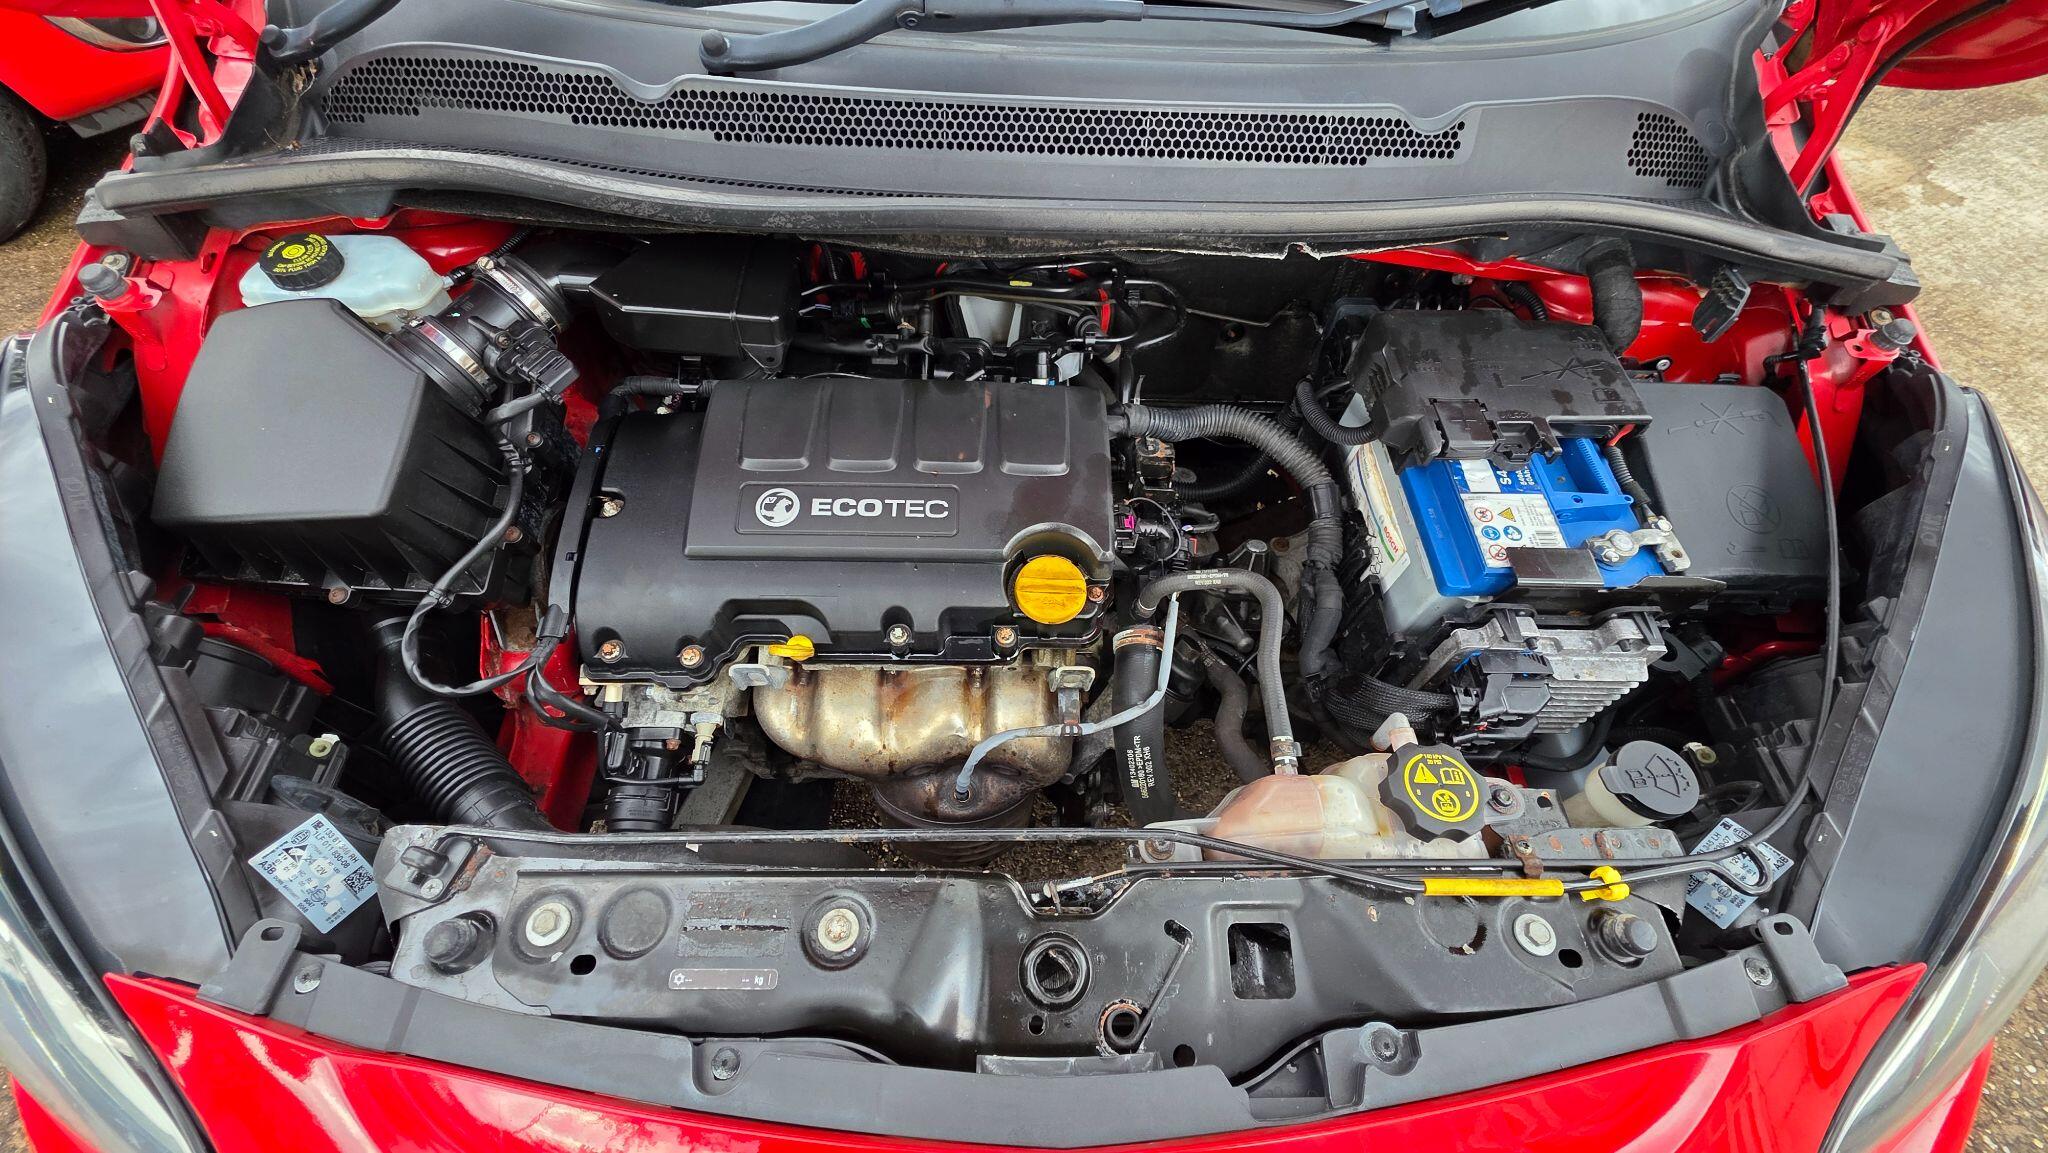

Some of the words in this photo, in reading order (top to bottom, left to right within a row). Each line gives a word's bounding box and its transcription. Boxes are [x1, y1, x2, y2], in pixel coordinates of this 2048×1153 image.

[1496, 470, 1512, 485] S4
[810, 498, 949, 518] ECOTEC
[1384, 526, 1398, 554] BOSCH
[1711, 832, 1722, 840] LH
[323, 828, 334, 840] 133
[348, 854, 360, 864] RH
[258, 860, 278, 875] A3B
[1774, 855, 1789, 870] A3B
[314, 865, 328, 877] 12V
[754, 976, 764, 986] kg
